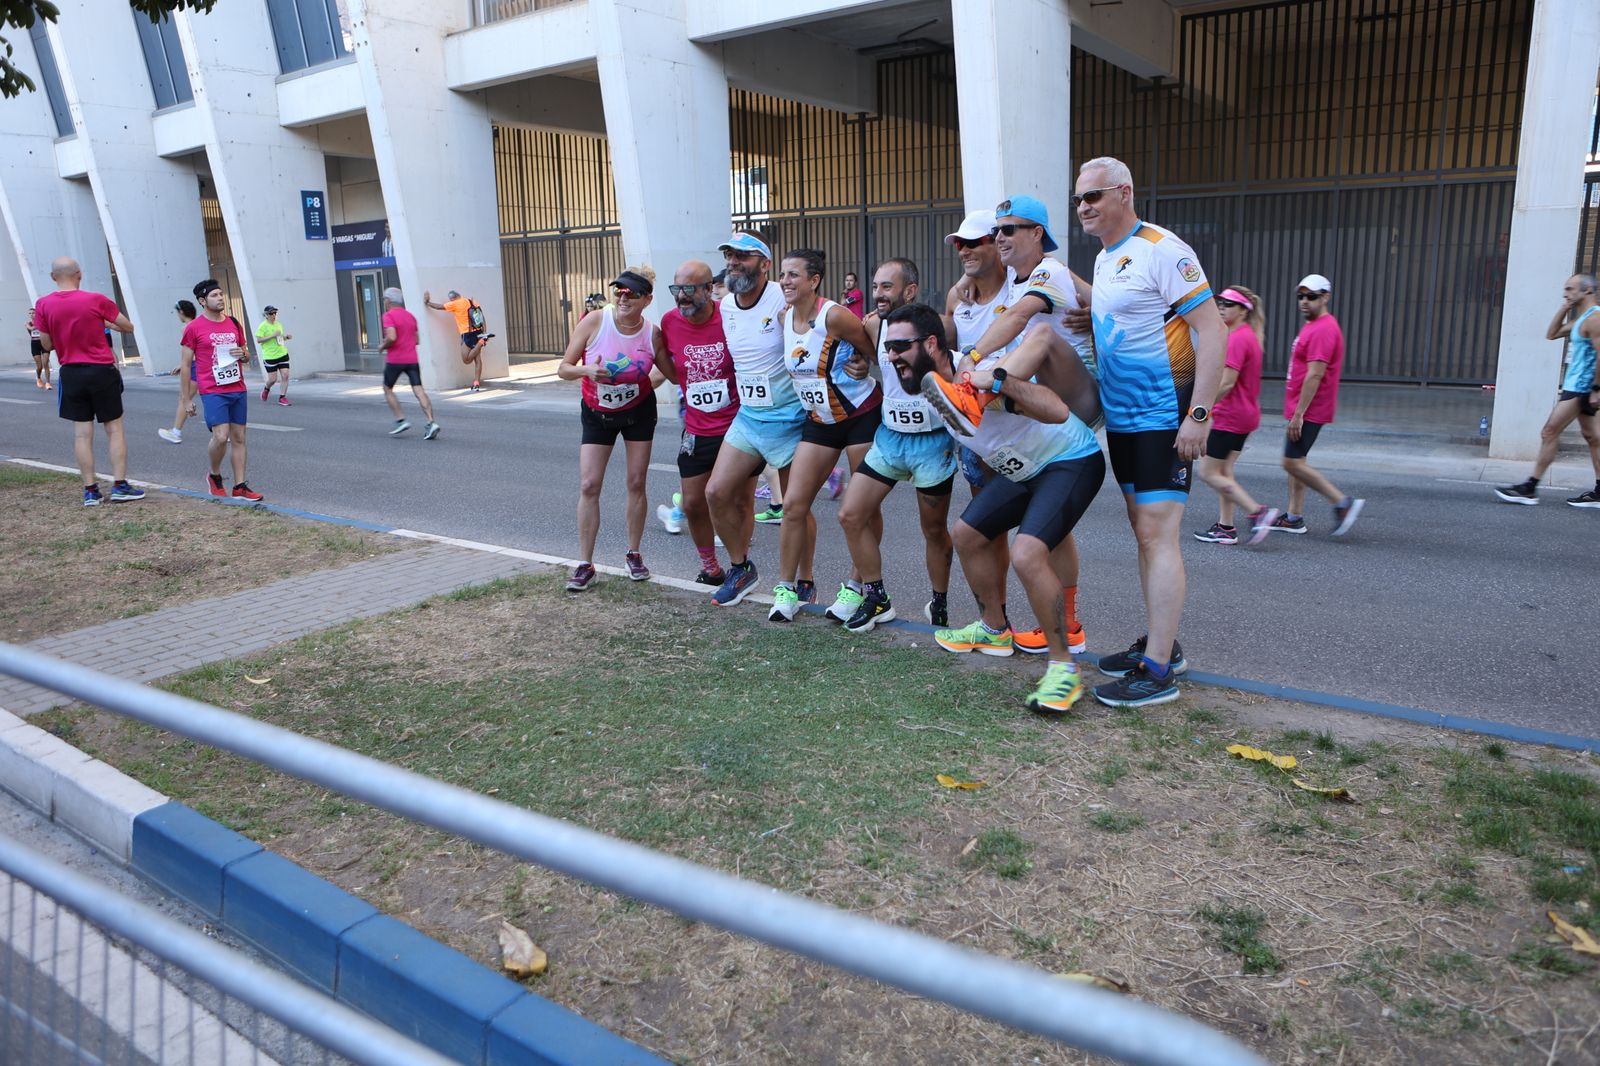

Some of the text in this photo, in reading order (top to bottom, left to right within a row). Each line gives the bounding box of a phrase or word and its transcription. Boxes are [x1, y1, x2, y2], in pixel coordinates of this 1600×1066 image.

[306, 197, 321, 208] P8
[336, 234, 354, 243] VARGAS
[217, 368, 239, 380] 532
[602, 390, 635, 403] 418
[692, 390, 723, 406] 307
[740, 385, 767, 398] 179
[800, 391, 825, 404] 493
[889, 410, 925, 424] 159
[997, 457, 1024, 476] 53
